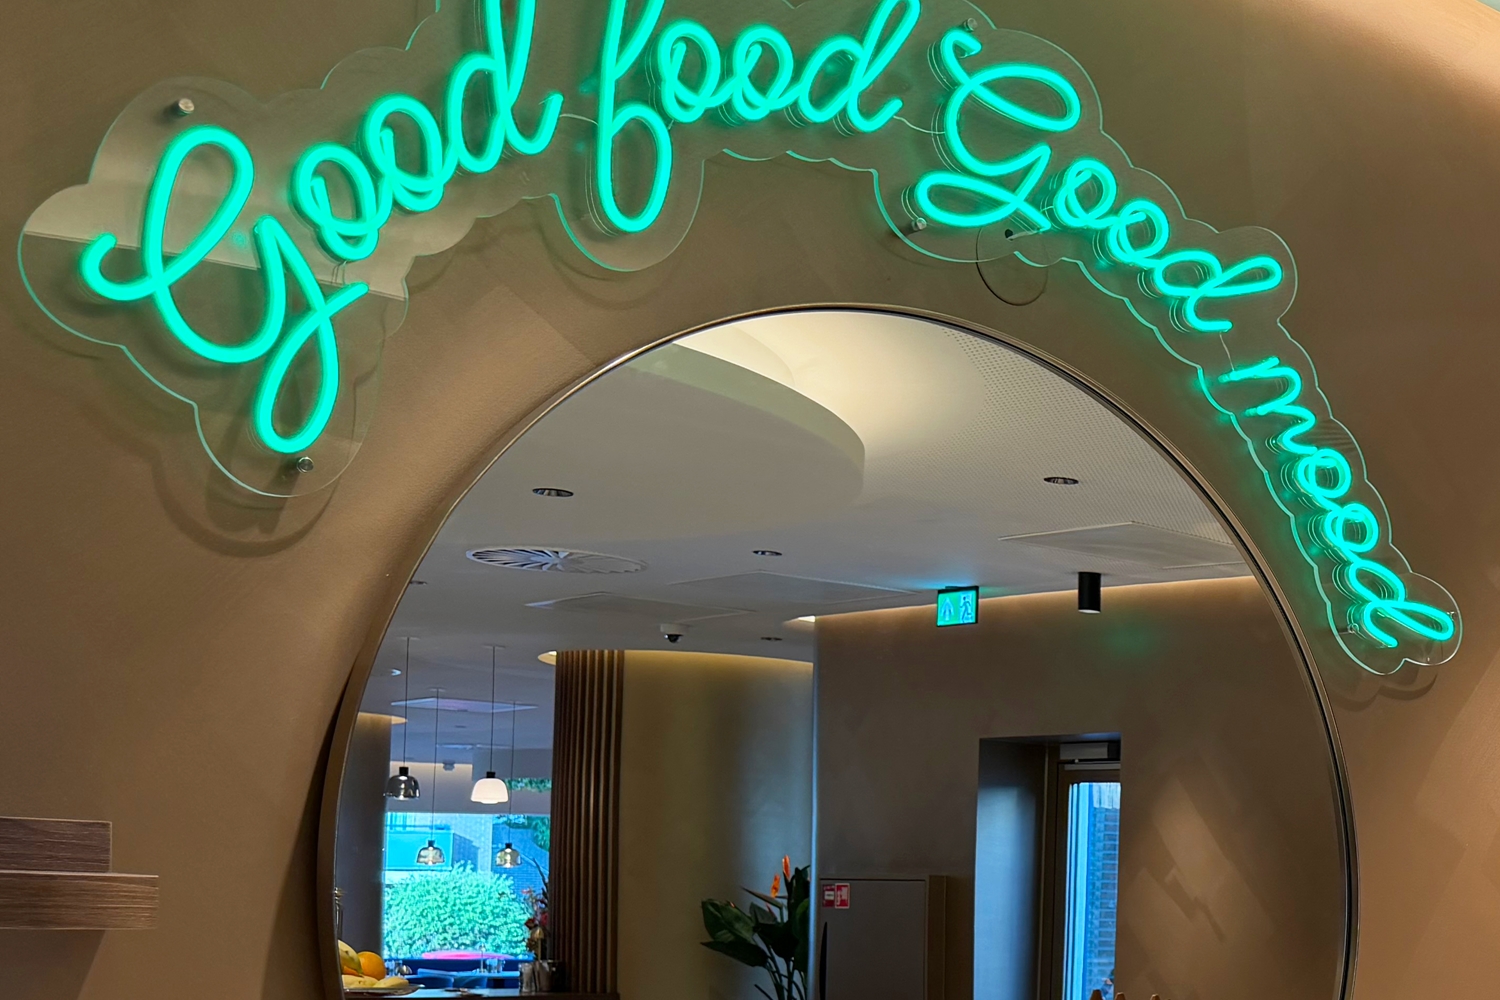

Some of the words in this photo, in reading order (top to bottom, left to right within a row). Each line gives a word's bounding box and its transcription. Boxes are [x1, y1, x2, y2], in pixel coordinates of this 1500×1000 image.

[78, 0, 564, 454] Good
[598, 0, 904, 233] food
[913, 27, 1283, 332] Good
[1218, 356, 1456, 649] mood
